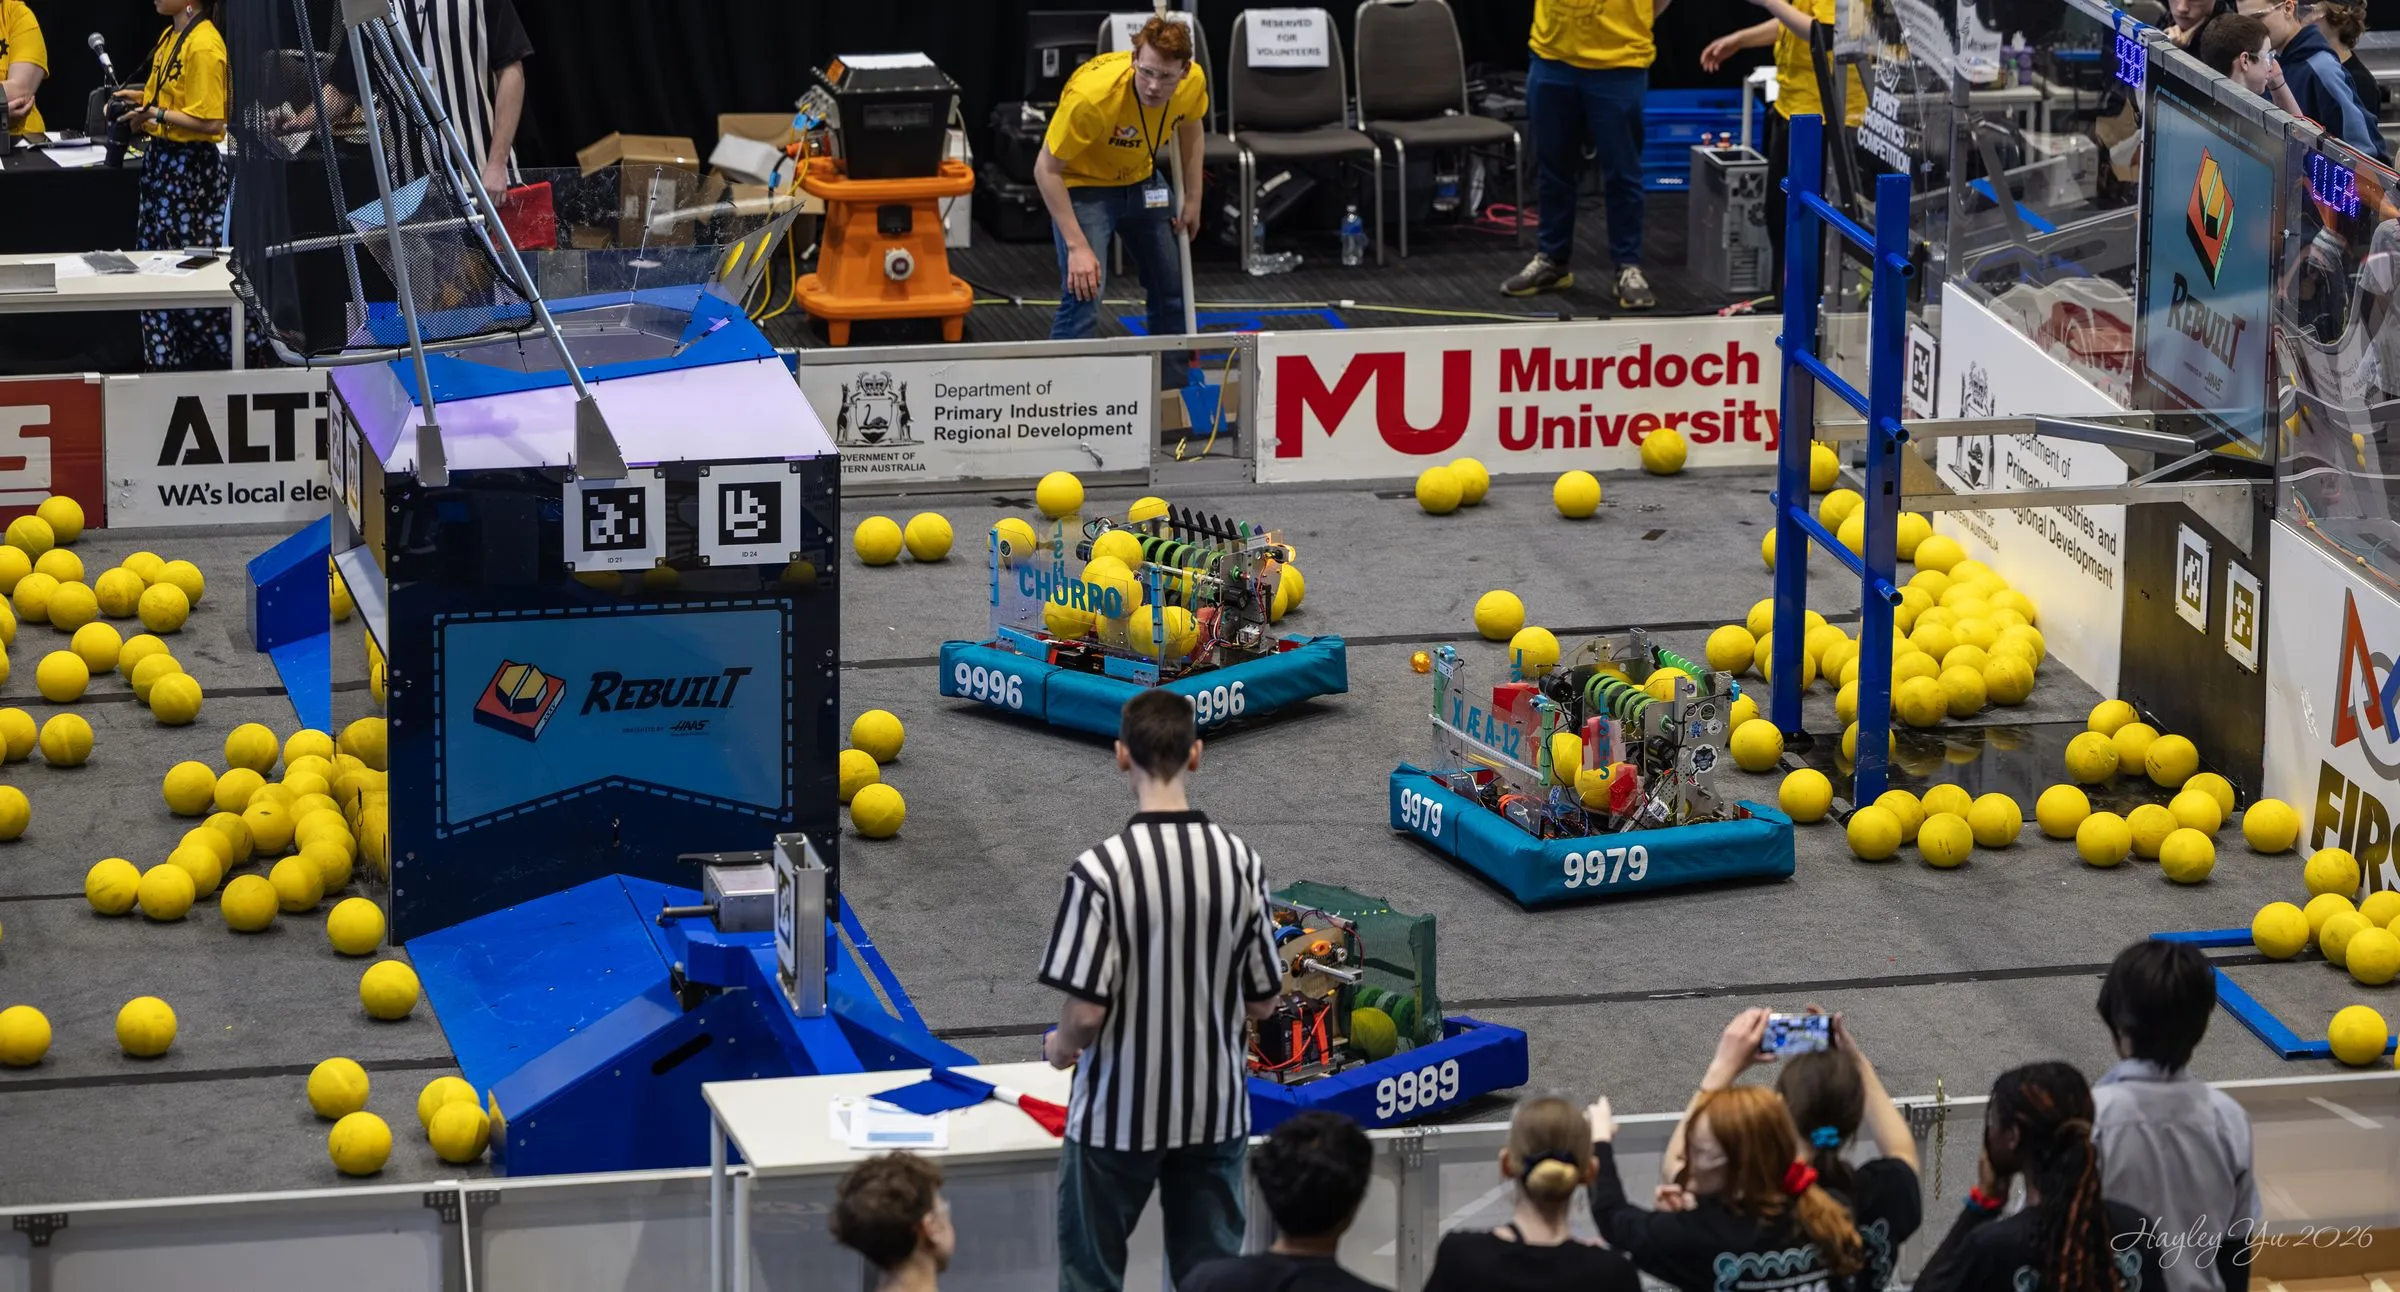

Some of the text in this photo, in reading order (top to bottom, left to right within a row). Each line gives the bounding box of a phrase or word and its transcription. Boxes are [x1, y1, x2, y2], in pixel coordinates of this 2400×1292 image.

[1261, 19, 1313, 28] RESERVED
[1277, 34, 1297, 43] FOR
[1257, 48, 1321, 57] VOLUNTEERS
[1871, 86, 1901, 121] FIRST
[1108, 137, 1143, 149] FIRST
[1864, 107, 1905, 148] ROBOTICS
[1857, 126, 1912, 175] COMPETITION
[2167, 272, 2247, 371] REBUILT
[1499, 340, 1760, 393] Murdoch
[935, 380, 1053, 401] Department of
[1275, 350, 1472, 459] MU
[934, 422, 1133, 443] Regional Development
[935, 401, 1138, 423] Primary Industries and
[1498, 398, 1780, 453] University
[840, 452, 916, 463] OVERNMENT OF
[841, 463, 926, 474] TERN AUSTRALIA
[2061, 458, 2072, 481] of
[157, 482, 222, 507] WA's
[228, 480, 284, 505] local
[2049, 520, 2113, 590] Development
[2098, 528, 2117, 557] and
[1019, 565, 1122, 619] CHURRO
[579, 667, 753, 717] REBUILT
[954, 662, 1024, 710] 9996
[1452, 696, 1462, 730] X
[1484, 714, 1521, 761] A-12
[1400, 788, 1443, 838] 9979
[2310, 759, 2400, 895] FIR
[1564, 845, 1649, 889] 9979
[1376, 1059, 1459, 1119] 9989
